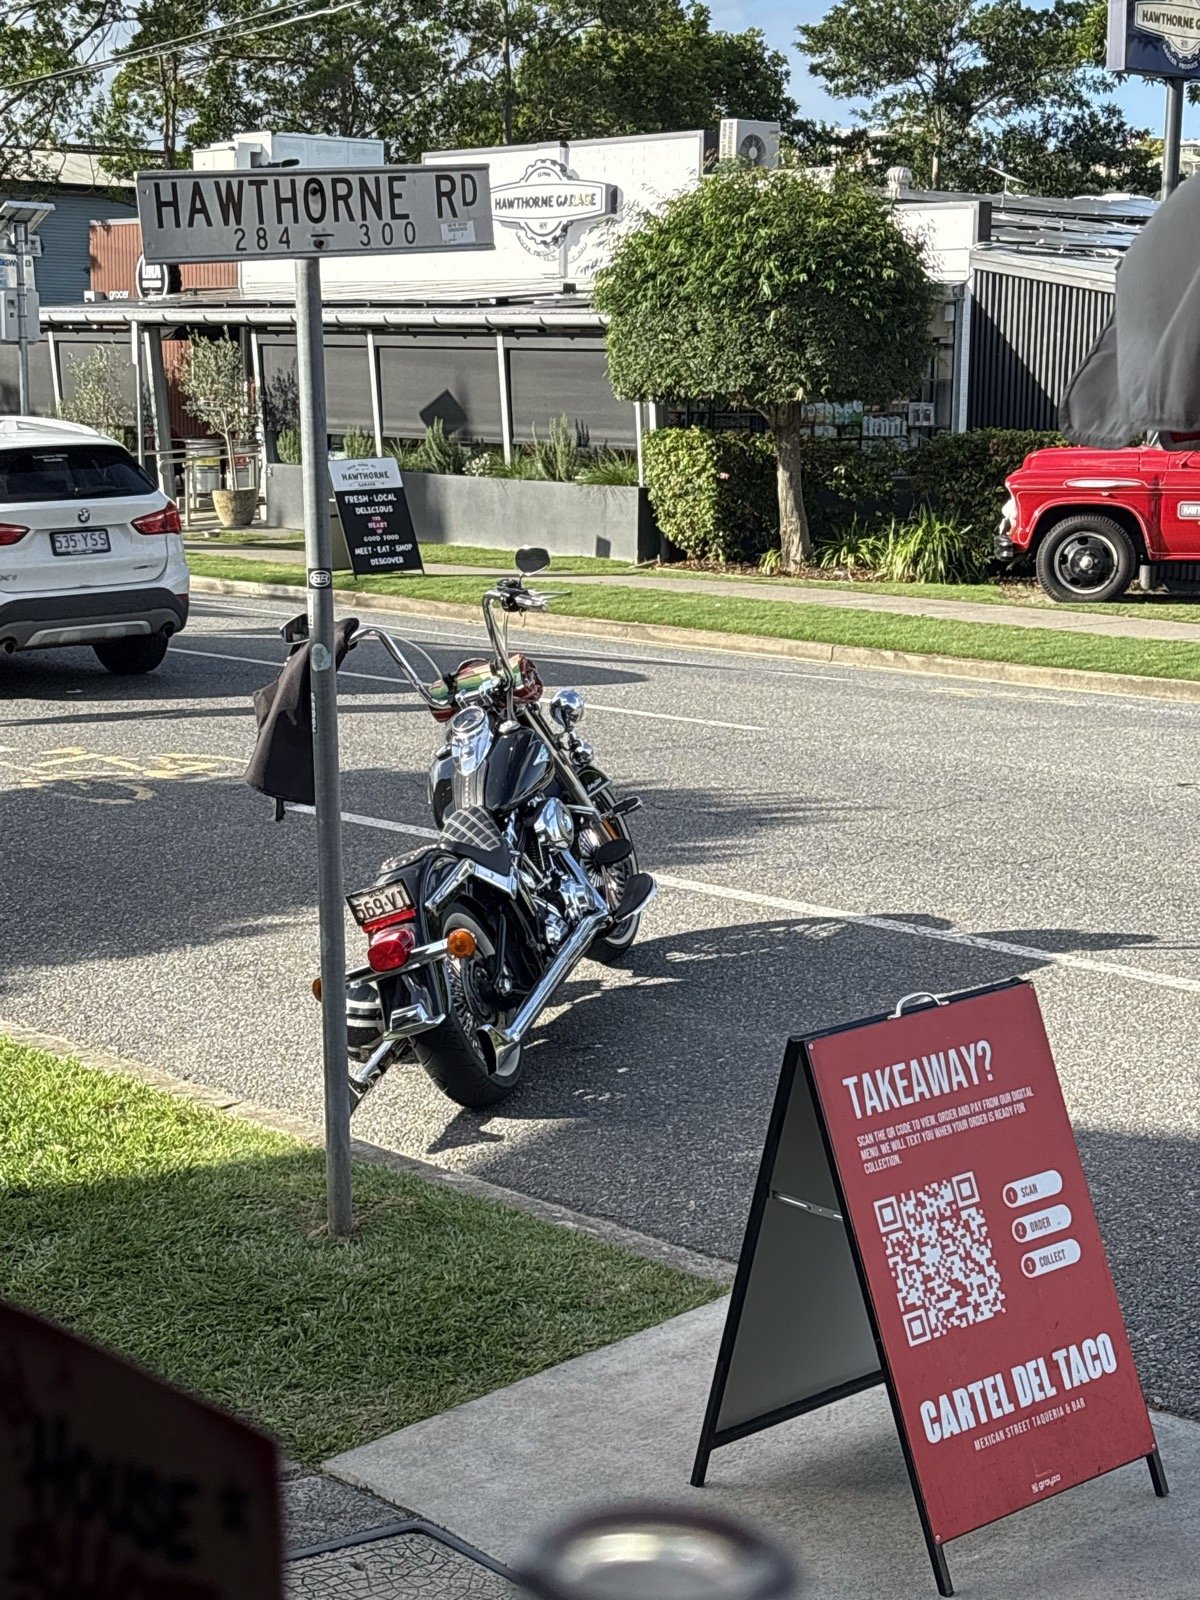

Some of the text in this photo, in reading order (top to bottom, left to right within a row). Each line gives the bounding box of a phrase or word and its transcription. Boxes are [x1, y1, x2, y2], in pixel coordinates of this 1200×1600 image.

[1142, 9, 1195, 30] HAWTHORNE
[153, 173, 478, 229] HAWTHORNE RD
[494, 195, 554, 211] HAWTHORNE
[233, 226, 291, 251] 284
[359, 221, 416, 247] 300
[341, 470, 390, 481] HAWTHORNE
[344, 493, 397, 504] FRESH LOCAL
[355, 505, 394, 515] DELICIOUS
[354, 543, 413, 555] MEET EAT SHOP
[370, 556, 405, 566] DISCOVER
[842, 1039, 994, 1120] TAKEAWAY?
[856, 1132, 874, 1147] SCAN
[873, 1129, 887, 1142] THE
[886, 1126, 896, 1138] QR
[895, 1121, 912, 1136] CODE
[911, 1118, 921, 1131] TO
[937, 1108, 958, 1123] ORDER
[957, 1104, 971, 1117] AND
[970, 1100, 983, 1114] PAY
[982, 1096, 1000, 1110] FROM
[999, 1092, 1012, 1105] OUR
[1010, 1086, 1035, 1101] DIGITAL
[880, 1142, 892, 1155] WE
[890, 1138, 907, 1151] WILL
[906, 1133, 922, 1147] TEXT
[921, 1129, 935, 1142] YOU
[934, 1124, 953, 1138] WHEN
[951, 1119, 969, 1133] YOUR
[968, 1113, 989, 1128] ORDER
[987, 1111, 995, 1123] IS
[994, 1106, 1014, 1120] READY
[1013, 1102, 1026, 1115] FOR
[863, 1153, 903, 1175] COLLECTION.
[1009, 1183, 1038, 1200] 1 SCAN
[1018, 1216, 1051, 1235] 2 ORDER
[1027, 1248, 1066, 1270] 3 COLLECT
[919, 1332, 1118, 1444] CARTEL DEL TACO
[973, 1397, 1086, 1451] MEXICAN STREET TAQUERIA & BAR
